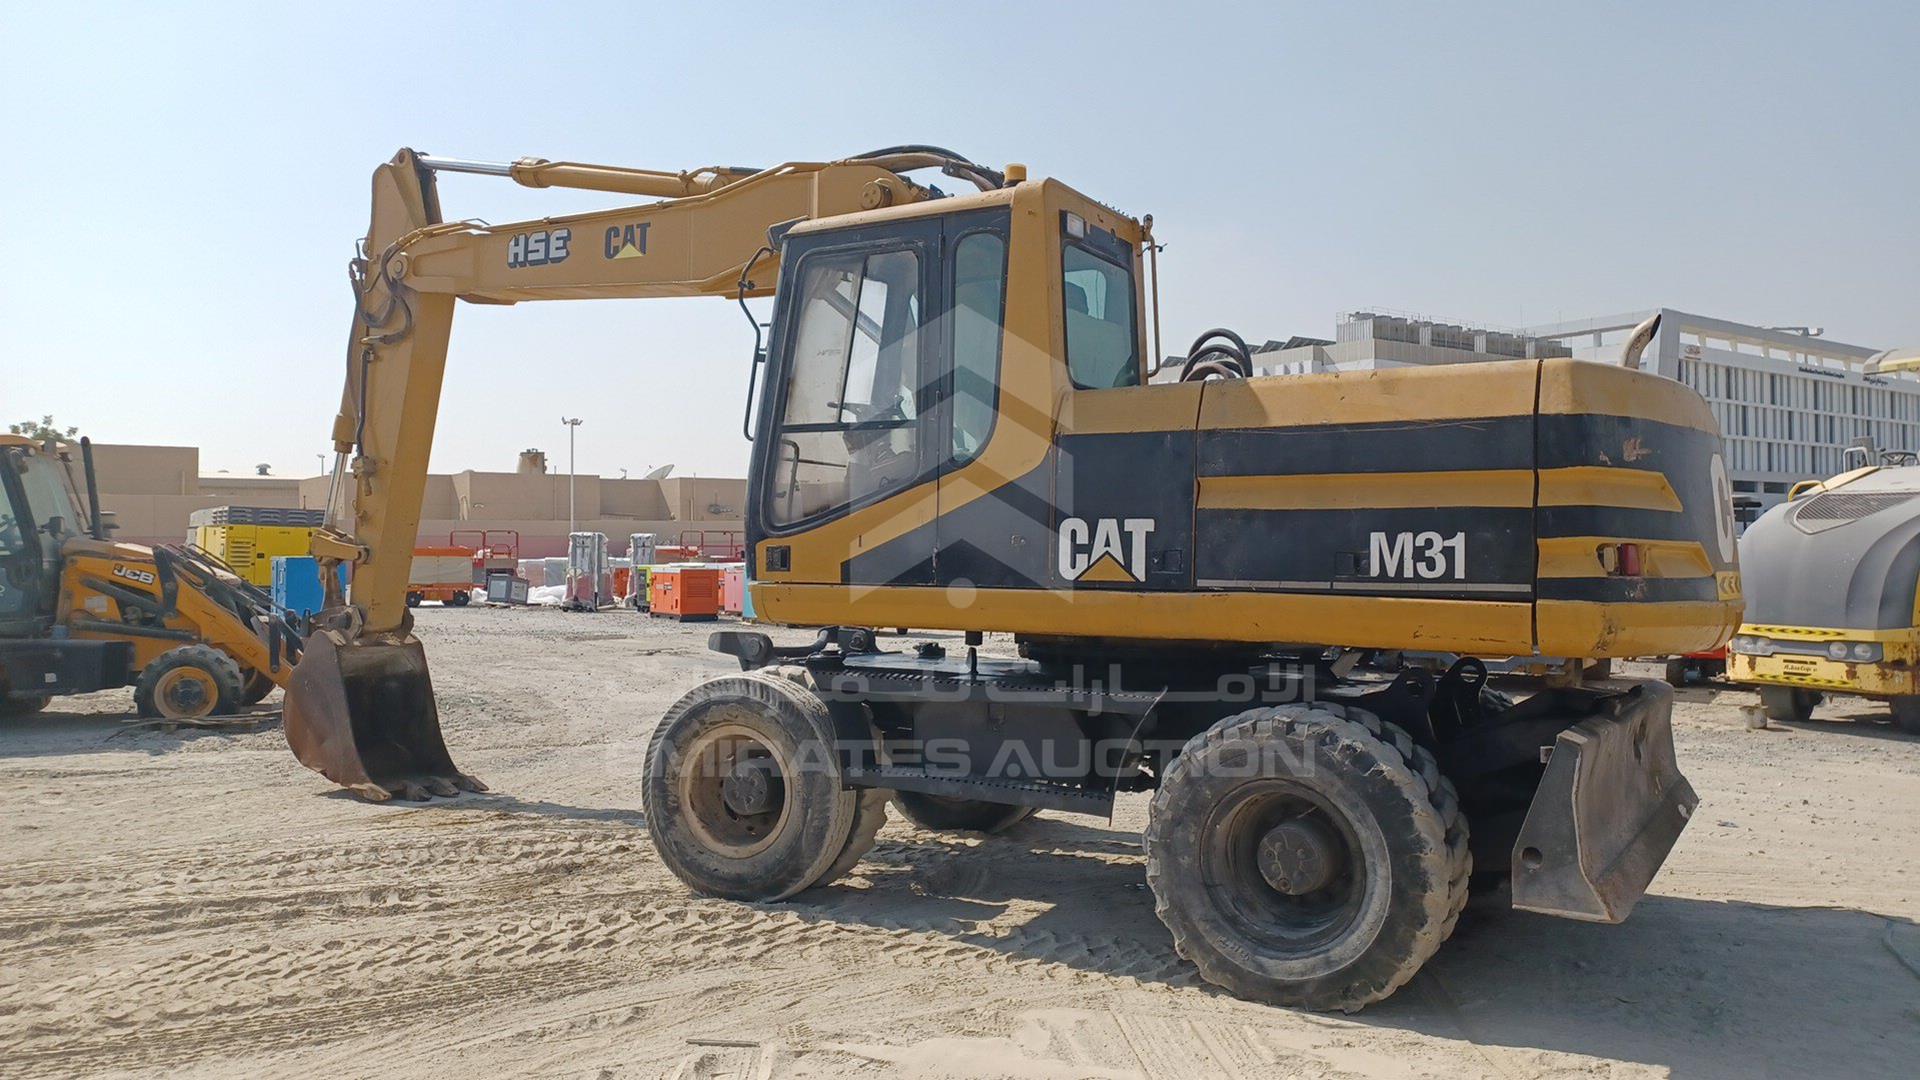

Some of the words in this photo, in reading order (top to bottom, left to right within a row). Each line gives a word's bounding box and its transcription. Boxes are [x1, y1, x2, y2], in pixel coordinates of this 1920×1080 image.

[507, 227, 572, 269] HSE
[604, 222, 651, 259] CAT
[1058, 517, 1155, 583] CAT
[1370, 531, 1466, 579] M31
[112, 563, 156, 585] JCB
